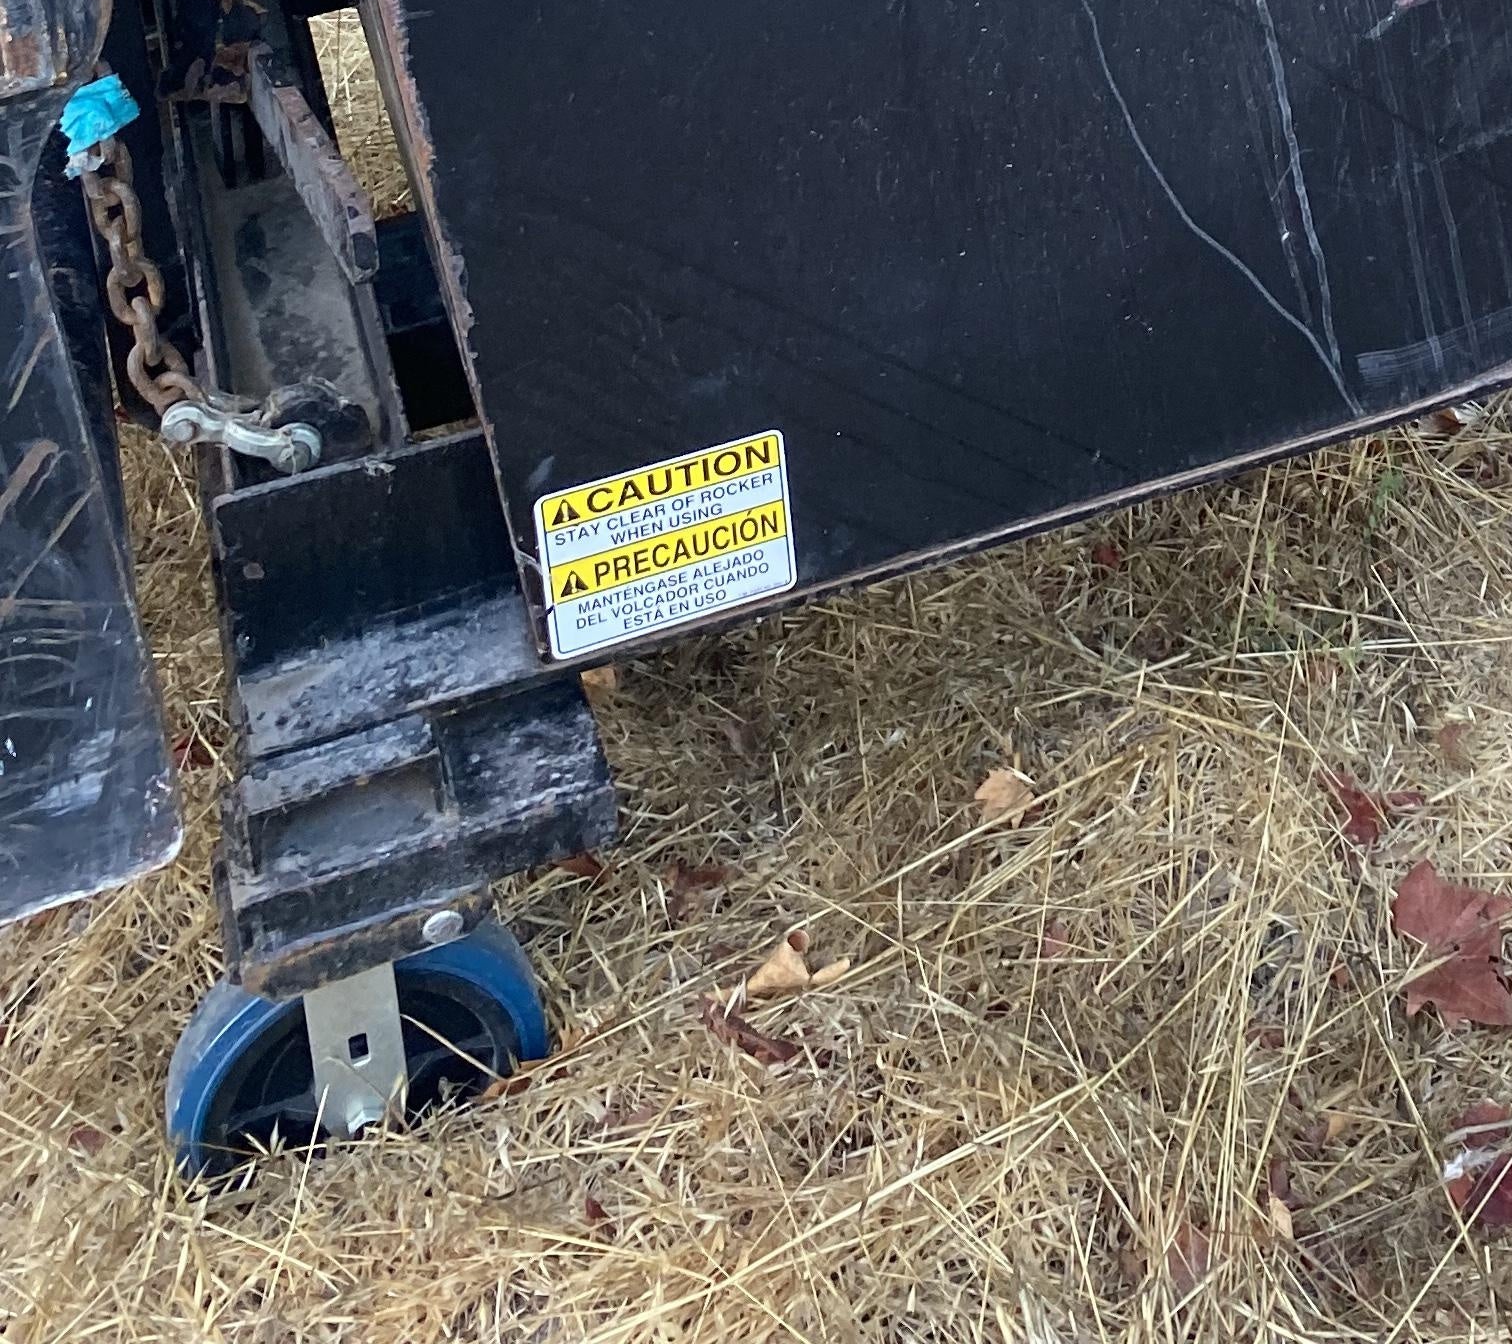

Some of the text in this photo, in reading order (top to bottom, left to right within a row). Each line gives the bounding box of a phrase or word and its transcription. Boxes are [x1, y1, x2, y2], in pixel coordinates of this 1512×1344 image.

[555, 472, 774, 546] STAY CLEAR OF ROCKER
[587, 440, 771, 513] CAUTION
[594, 510, 779, 587] PRECAUCIÓN
[610, 504, 723, 545] WHEN USING
[576, 611, 608, 630] DEL
[611, 583, 699, 618] VOLCADOR
[703, 562, 770, 590] CUANDO
[578, 549, 764, 615] MANTÉNGASE ALEJADO
[623, 589, 727, 630] ESTÁ EN USO
